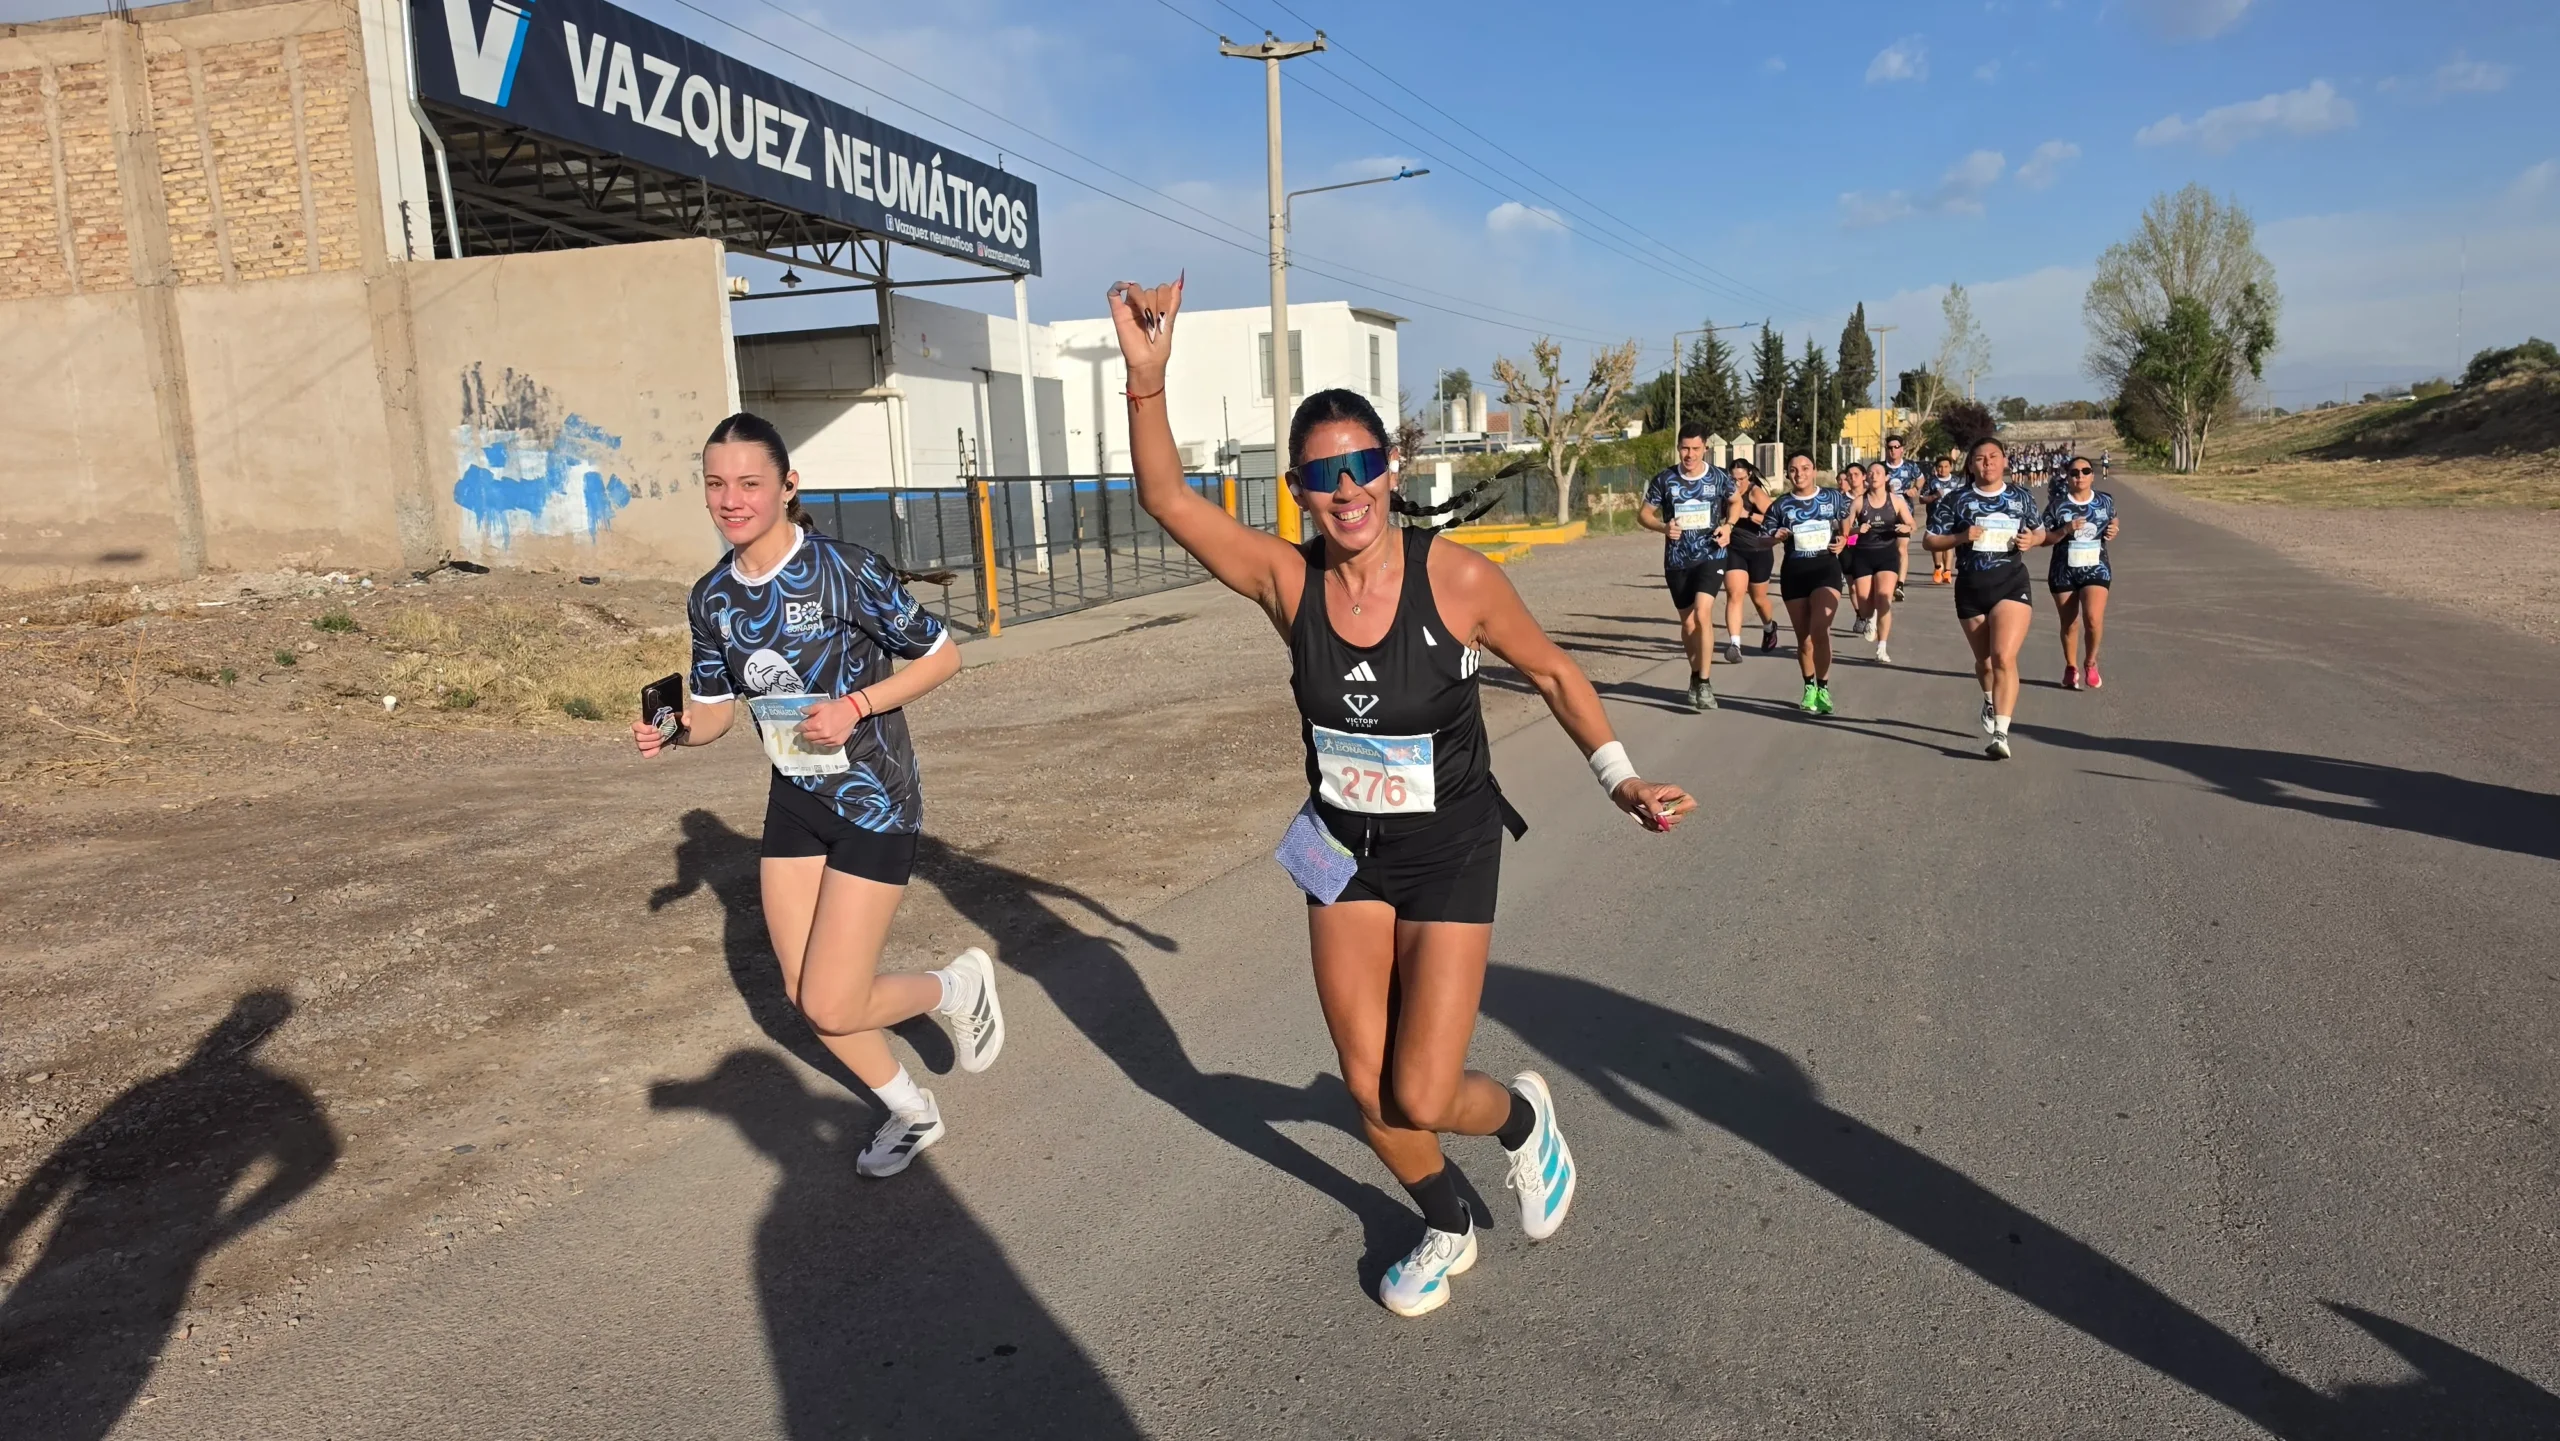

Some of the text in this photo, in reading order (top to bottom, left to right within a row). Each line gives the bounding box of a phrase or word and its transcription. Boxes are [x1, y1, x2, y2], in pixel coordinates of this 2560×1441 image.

[563, 20, 1028, 249] VAZQUEZ NEUMÁTICOS
[894, 218, 928, 240] Vazquez
[929, 231, 974, 253] neumaticos
[1345, 717, 1379, 725] VICTORY
[1335, 744, 1382, 758] BONARDA
[1341, 766, 1408, 807] 276
